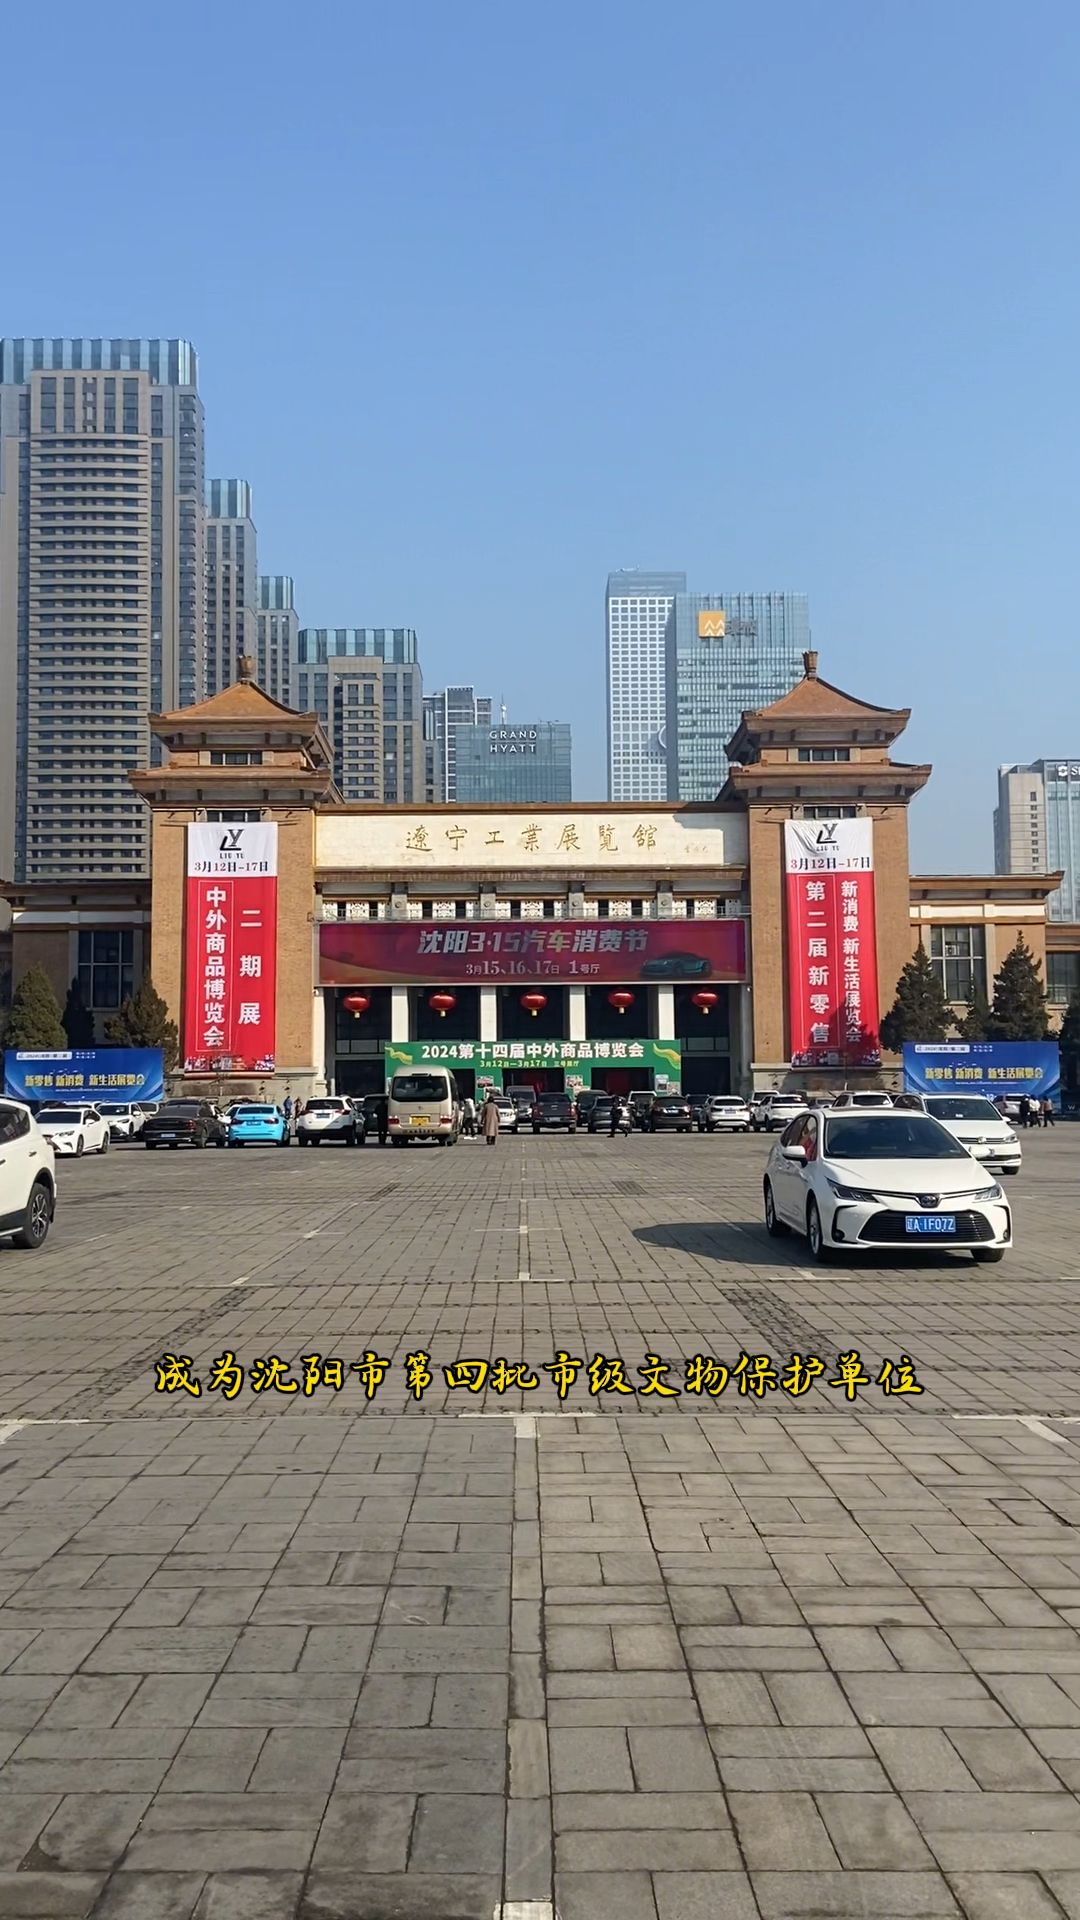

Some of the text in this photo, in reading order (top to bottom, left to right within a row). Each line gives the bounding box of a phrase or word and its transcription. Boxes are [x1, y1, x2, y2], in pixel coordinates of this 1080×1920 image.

[490, 730, 537, 739] GRAND
[490, 744, 536, 753] HYATT
[203, 886, 227, 1047] 中外商品博览会
[238, 909, 262, 1026] 二期展
[569, 960, 600, 974] 1号厅
[806, 881, 830, 1043] 第二届新零售
[841, 881, 862, 1043] 新消费 新生活展览会
[421, 1042, 645, 1059] 2024第十四届中外商品博览会
[25, 1074, 53, 1087] 新零售
[55, 1074, 84, 1087] 新消费
